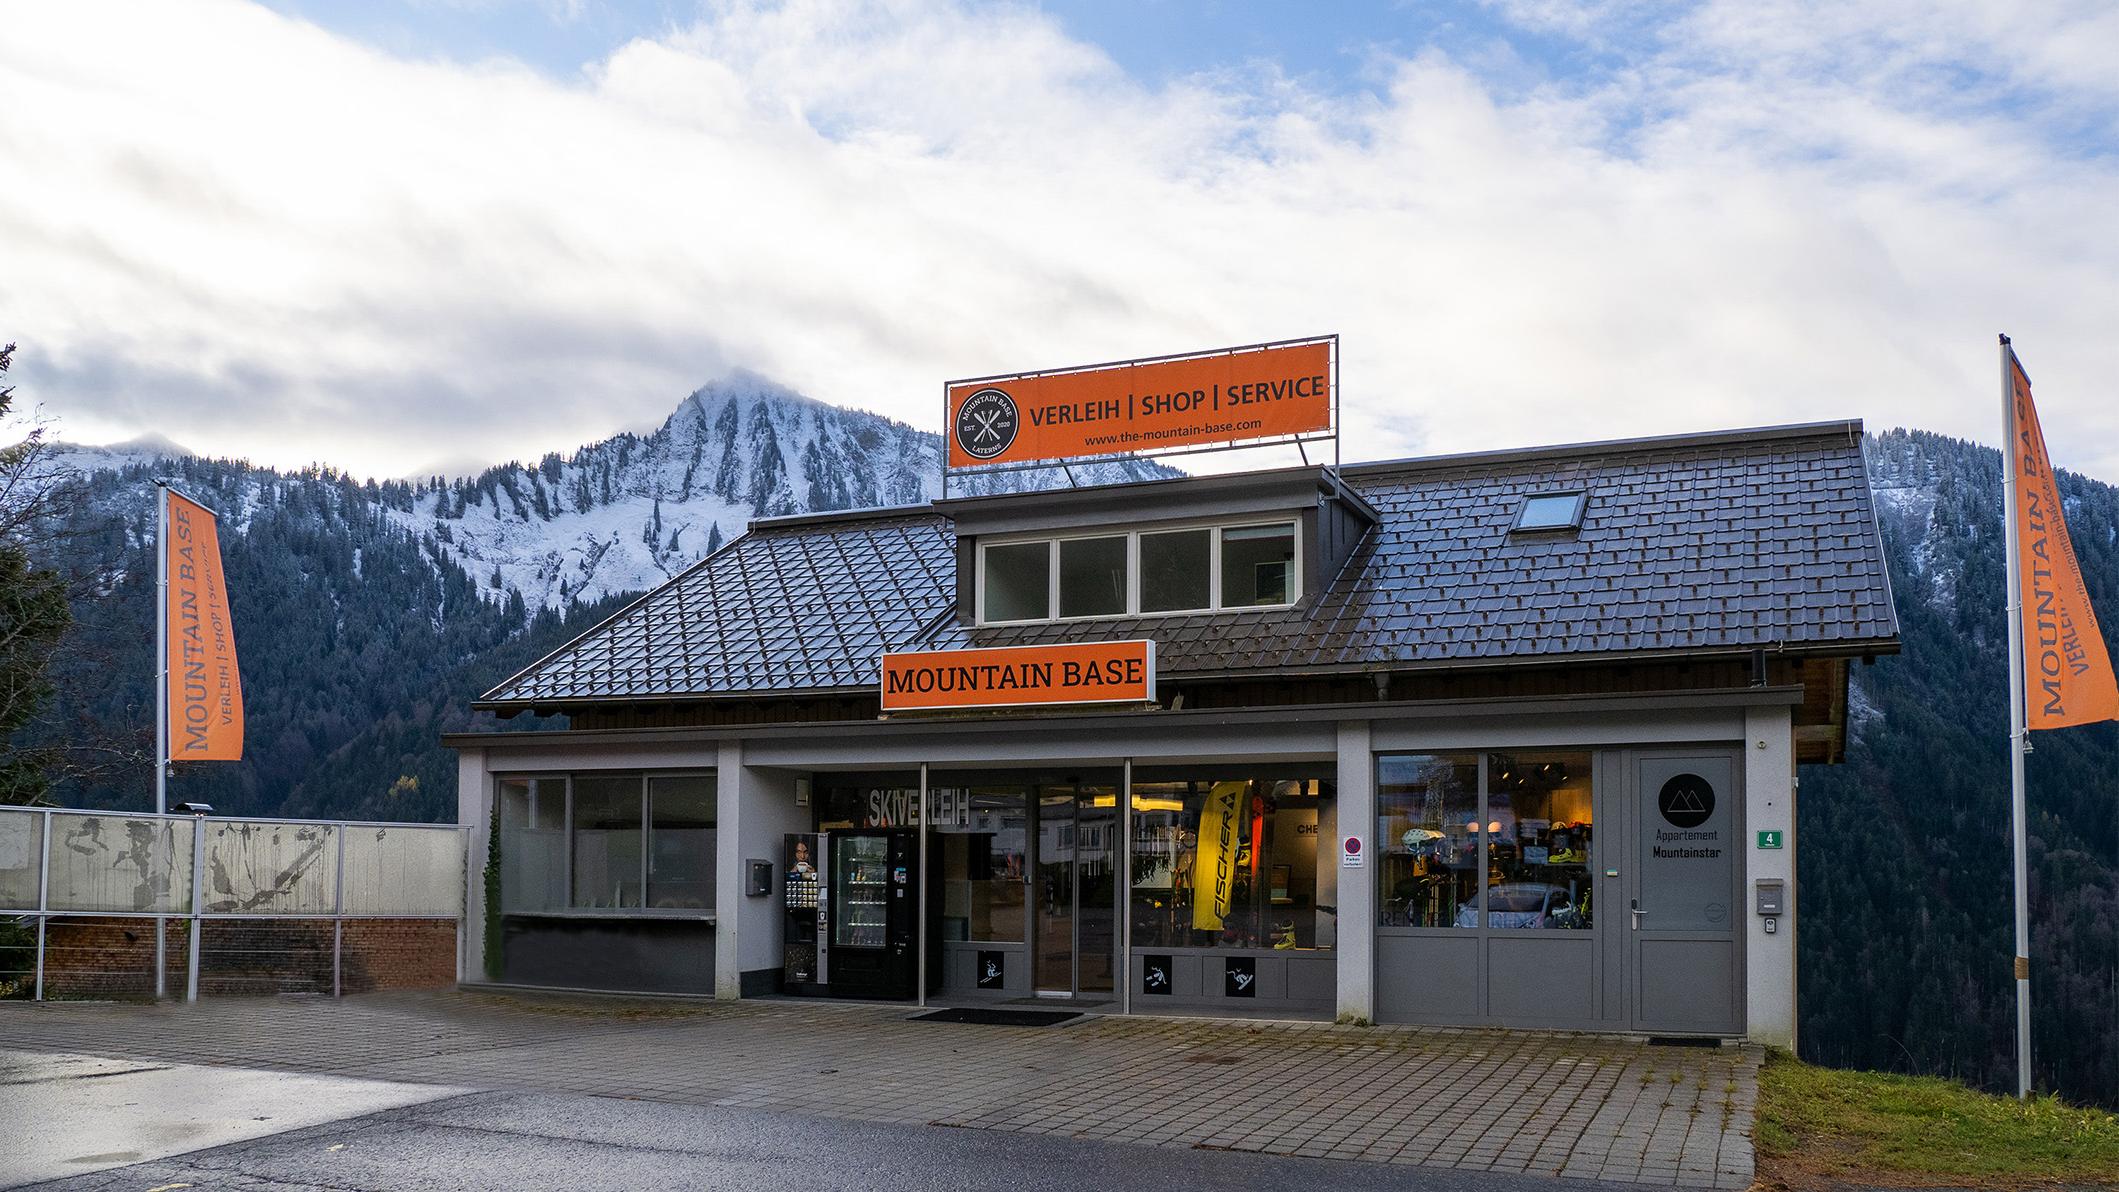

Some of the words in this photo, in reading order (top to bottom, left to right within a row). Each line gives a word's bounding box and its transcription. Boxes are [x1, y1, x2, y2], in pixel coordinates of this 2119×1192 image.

[962, 395, 998, 421] MOUNTAIN
[997, 398, 1013, 418] BASE
[1029, 399, 1120, 427] VERLEIH
[1141, 390, 1206, 417] SHOP
[1227, 375, 1324, 406] SERVICE
[971, 443, 1002, 454] LATERNS
[1084, 419, 1262, 446] www.the-mountain-base.com
[176, 507, 197, 582] BASE
[2026, 488, 2065, 717] MOUNTAIN
[211, 612, 226, 652] SHOP
[181, 588, 209, 752] MOUNTAIN
[887, 663, 1053, 694] MOUNTAIN
[1062, 658, 1144, 688] BASE
[218, 665, 233, 726] VERLEIH
[1652, 845, 1722, 859] Mountainstar
[1655, 828, 1718, 843] Appartement
[1766, 832, 1774, 844] 4
[1213, 810, 1233, 919] FISCHER
